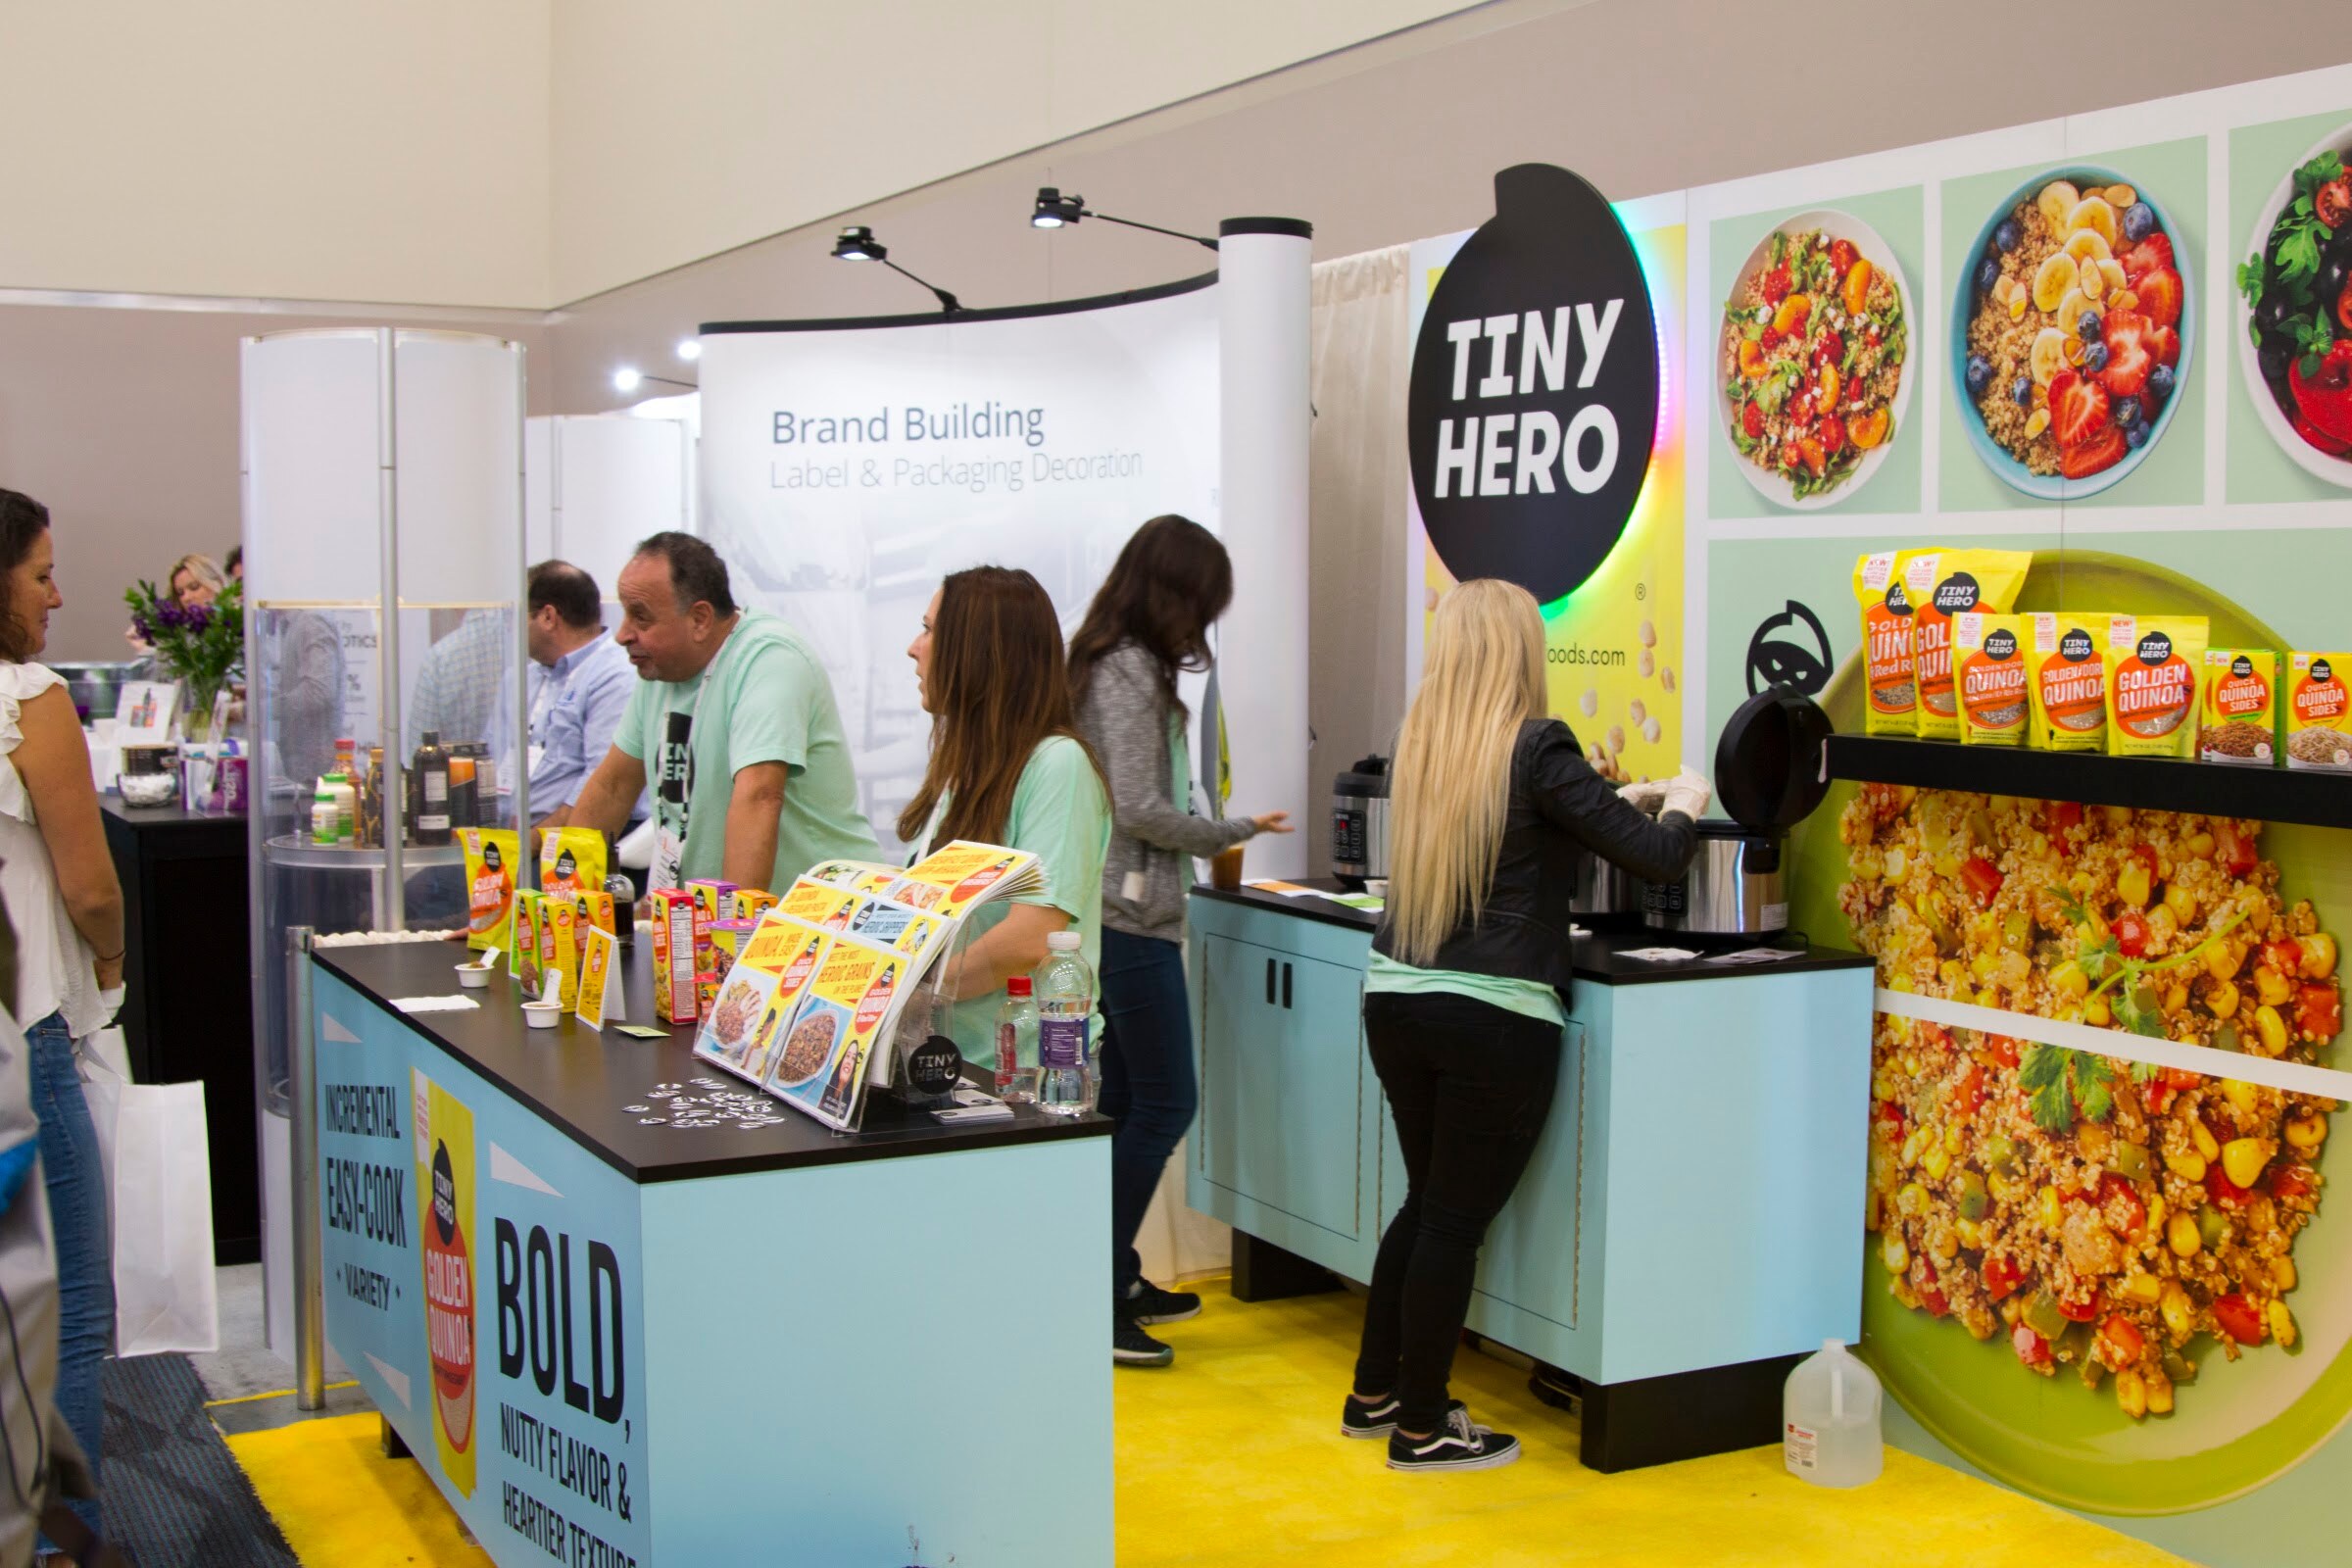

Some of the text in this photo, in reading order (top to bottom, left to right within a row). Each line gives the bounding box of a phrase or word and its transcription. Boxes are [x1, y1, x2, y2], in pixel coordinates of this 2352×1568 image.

[1446, 298, 1624, 401] TINY
[772, 401, 1045, 447] Brand Building
[1435, 404, 1619, 498] HERO
[771, 447, 1144, 493] Label & Packaging Decoration
[1936, 596, 1974, 607] HERO
[1940, 585, 1976, 598] TINY
[1869, 617, 1913, 633] GOLD
[1917, 622, 1951, 653] GOL
[1545, 642, 1625, 666] oods.com
[1870, 630, 1913, 662] UIN
[1988, 638, 2014, 647] TINY
[2062, 647, 2090, 656] HERO
[2139, 650, 2169, 659] HERO
[2141, 642, 2170, 651] TINY
[1918, 647, 1952, 680] QUI
[2119, 663, 2187, 691] GOLDEN
[1965, 668, 2027, 694] QUINOA
[2043, 677, 2106, 706] QUINOA
[2219, 684, 2266, 703] QUINOA
[2228, 678, 2256, 689] QUICK
[2305, 682, 2334, 693] QUICK
[2119, 685, 2185, 712] QUINOA
[2230, 699, 2258, 712] SIDES
[2297, 688, 2345, 708] QUINOA
[2308, 704, 2337, 717] SIDES
[664, 743, 689, 760] IN
[663, 763, 687, 780] ER
[916, 1054, 956, 1068] TINY
[916, 1066, 956, 1080] HERO
[325, 1085, 401, 1139] INCREMENTAL
[434, 1170, 454, 1200] TINY
[326, 1157, 408, 1249] EASY-COOK
[434, 1196, 455, 1225] HERO
[344, 1262, 390, 1310] VARIETY
[424, 1249, 469, 1307] GOLDEN
[428, 1307, 471, 1365] QUINOA
[495, 1217, 630, 1444] BOLD,
[500, 1401, 632, 1523] NUTTY FLAVOR &
[502, 1480, 636, 1568] HEARTIER TEXT
